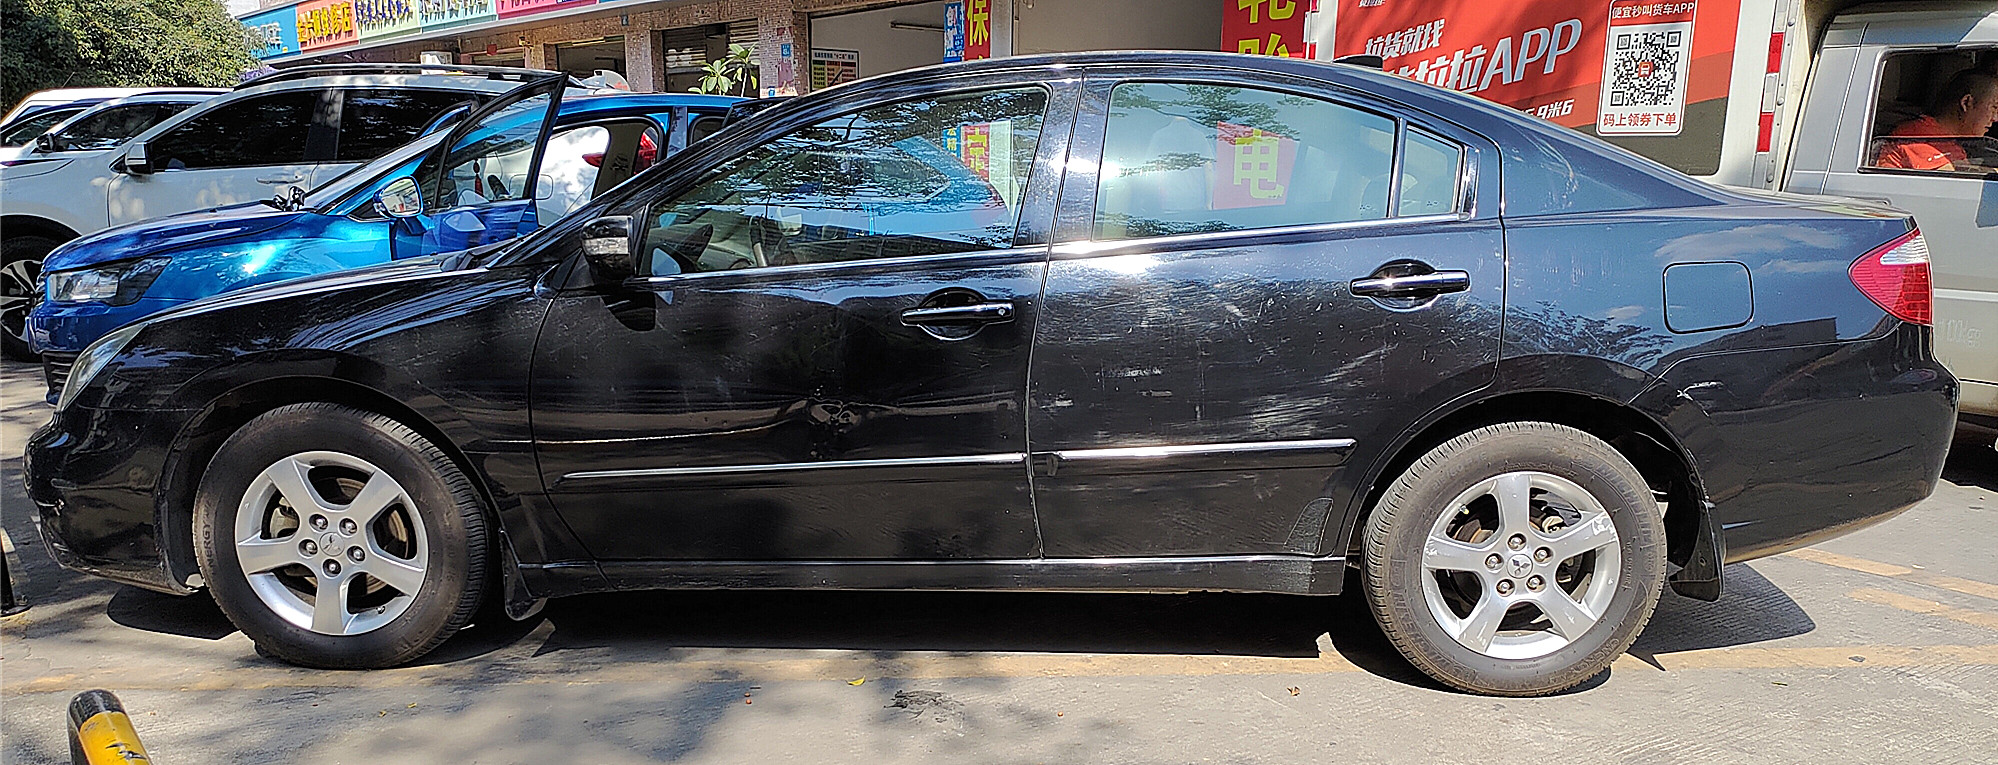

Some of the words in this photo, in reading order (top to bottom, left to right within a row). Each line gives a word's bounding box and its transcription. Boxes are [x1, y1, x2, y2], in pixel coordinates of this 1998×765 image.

[1611, 2, 1695, 19] 便宜秒叫货车APP
[1365, 18, 1446, 59] 拉货就找
[1603, 112, 1678, 128] 码上领券下单
[1233, 127, 1285, 199] 电
